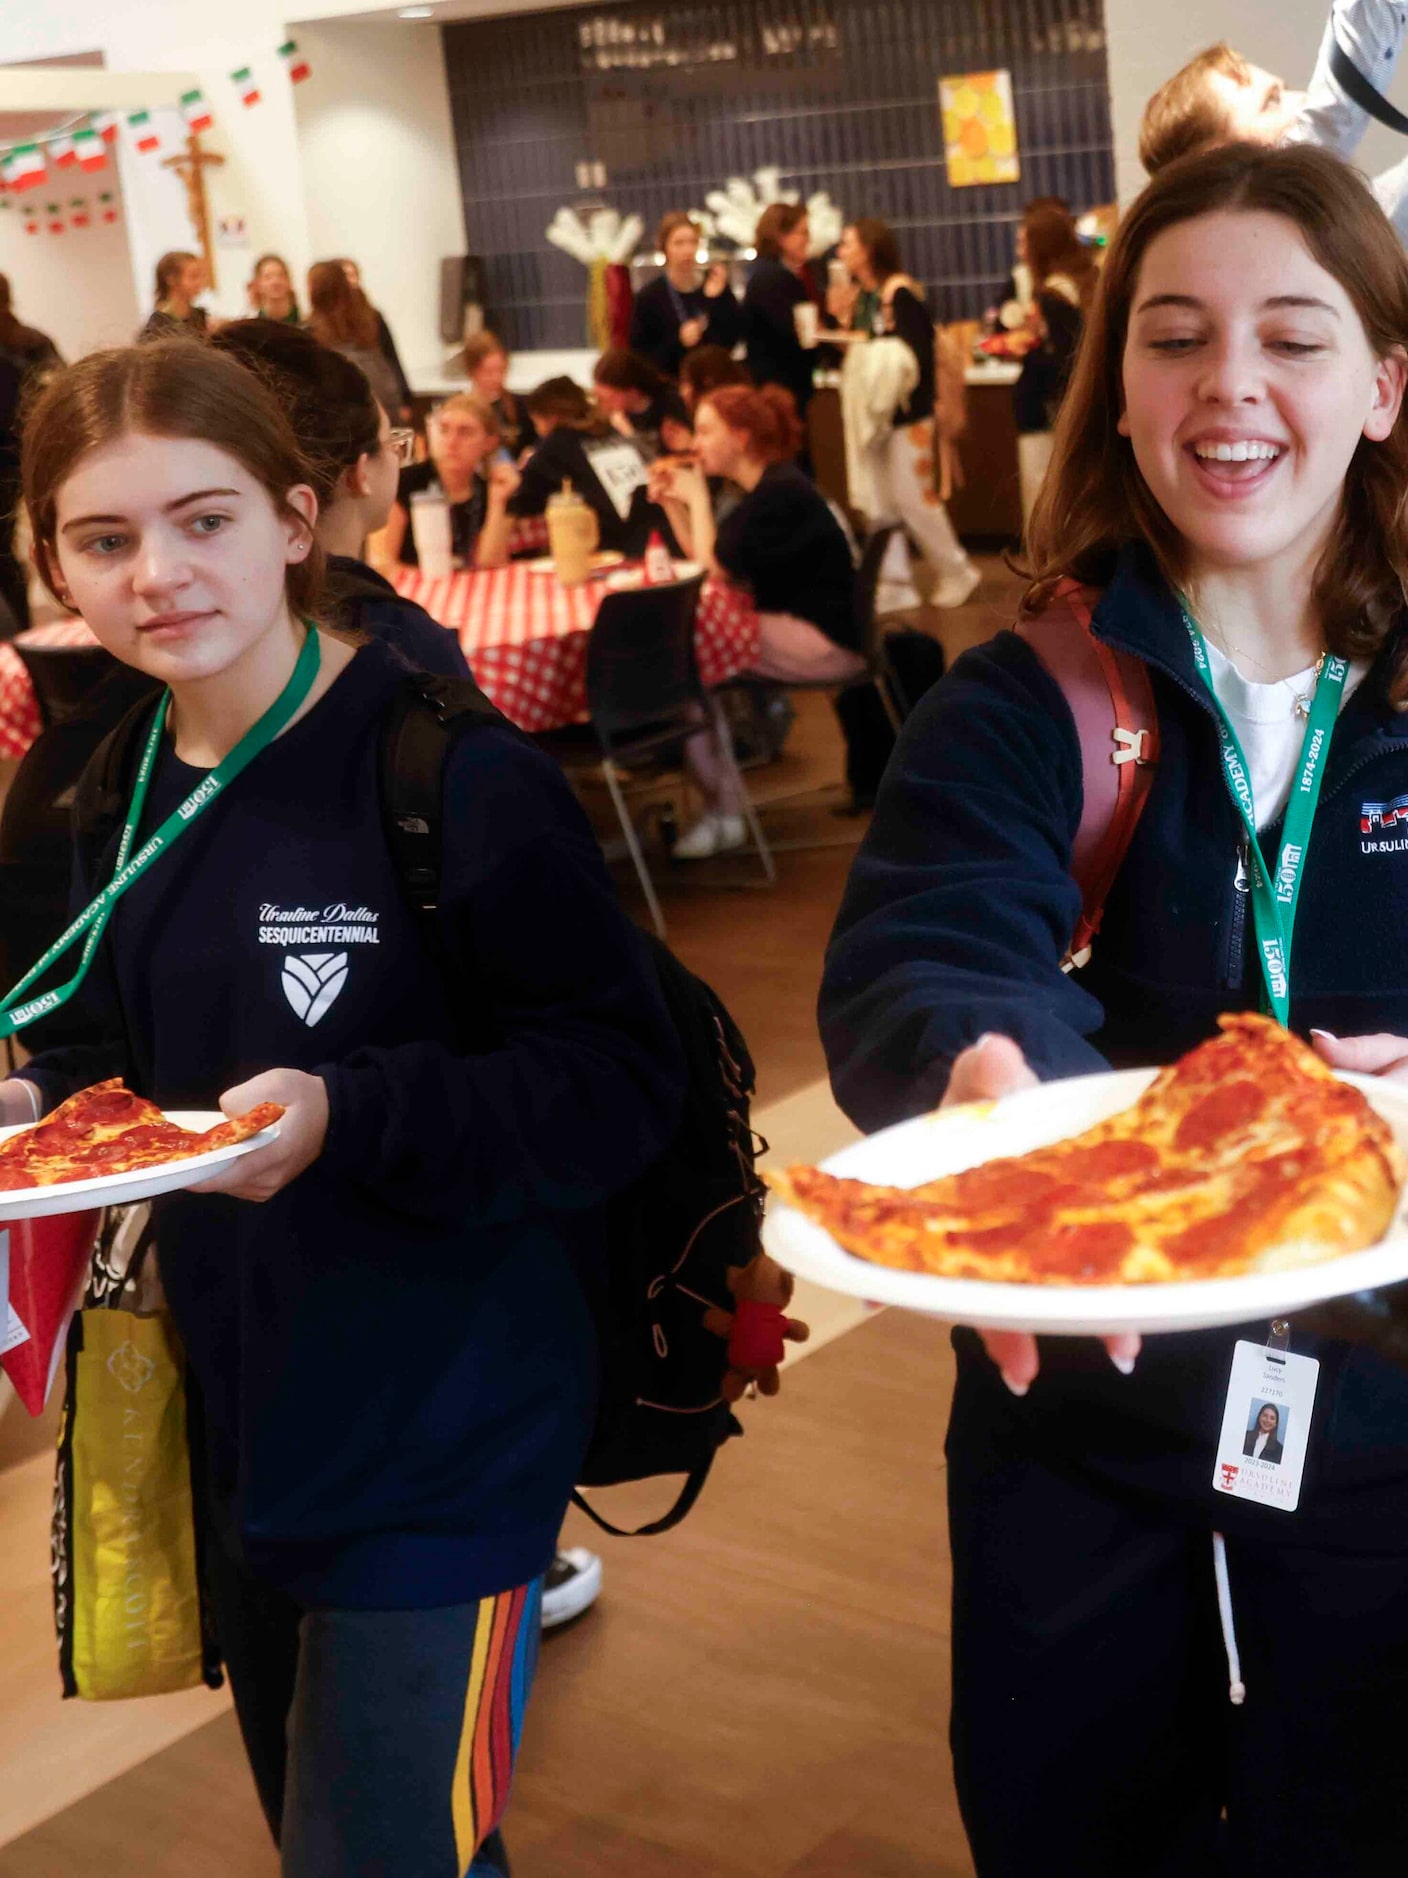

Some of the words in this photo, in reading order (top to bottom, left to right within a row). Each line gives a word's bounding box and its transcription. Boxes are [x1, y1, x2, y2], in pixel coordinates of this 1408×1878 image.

[1300, 728, 1325, 793] 1874-2024
[106, 836, 164, 896] URSULINE
[1276, 868, 1297, 905] 150
[51, 893, 107, 954] ACADEMY
[258, 902, 320, 923] Ursuline
[320, 902, 380, 923] Dallas
[258, 926, 381, 947] SESQUICENTENNIAL
[1262, 937, 1284, 974] 150
[1243, 1457, 1276, 1472] 2023-2024
